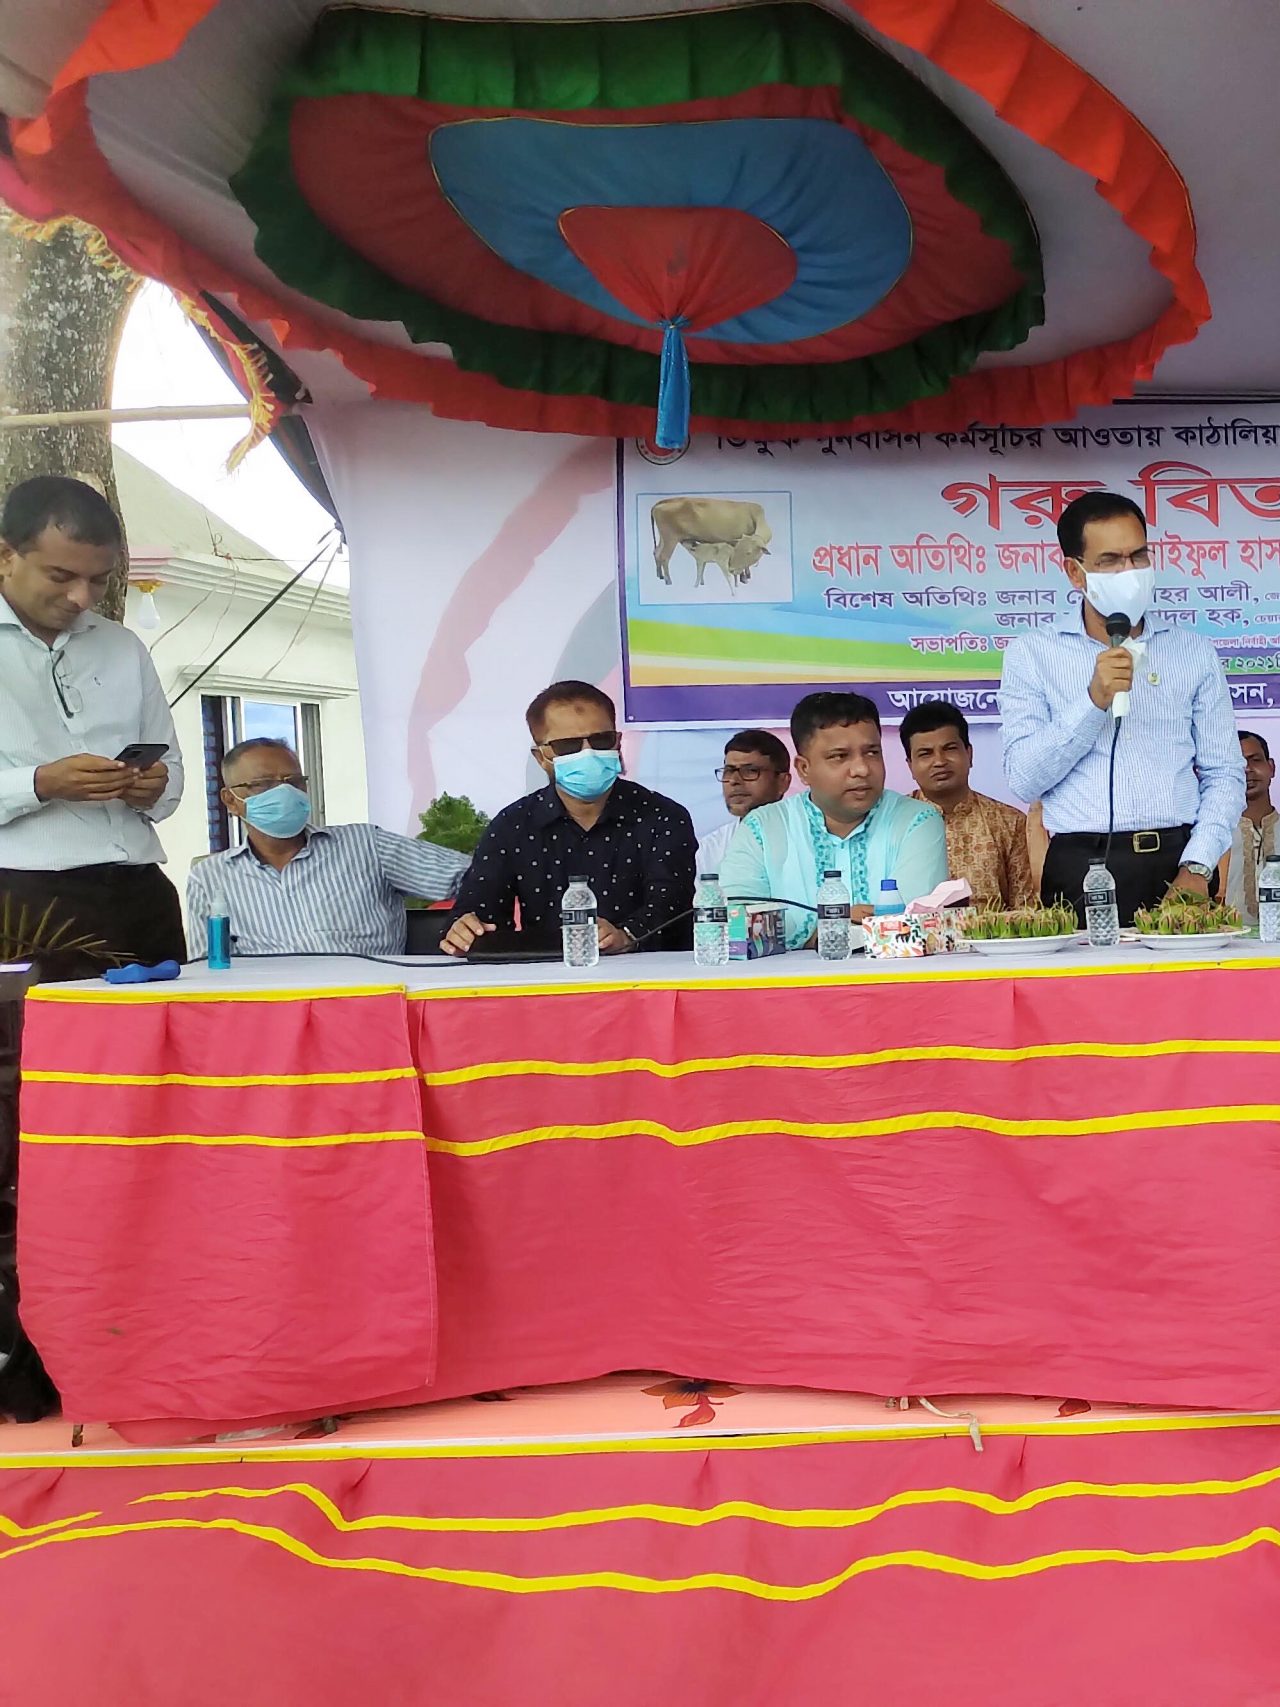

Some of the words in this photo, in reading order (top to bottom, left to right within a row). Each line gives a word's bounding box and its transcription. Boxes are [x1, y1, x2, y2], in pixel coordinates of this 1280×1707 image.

[1052, 424, 1164, 448] আওতায়
[812, 541, 882, 578] প্রধান
[824, 586, 894, 609] বিশেষ
[995, 588, 1056, 606] জনাব
[1198, 580, 1260, 605] আলী,
[995, 611, 1056, 628] জনাব
[1205, 608, 1250, 628] হক,
